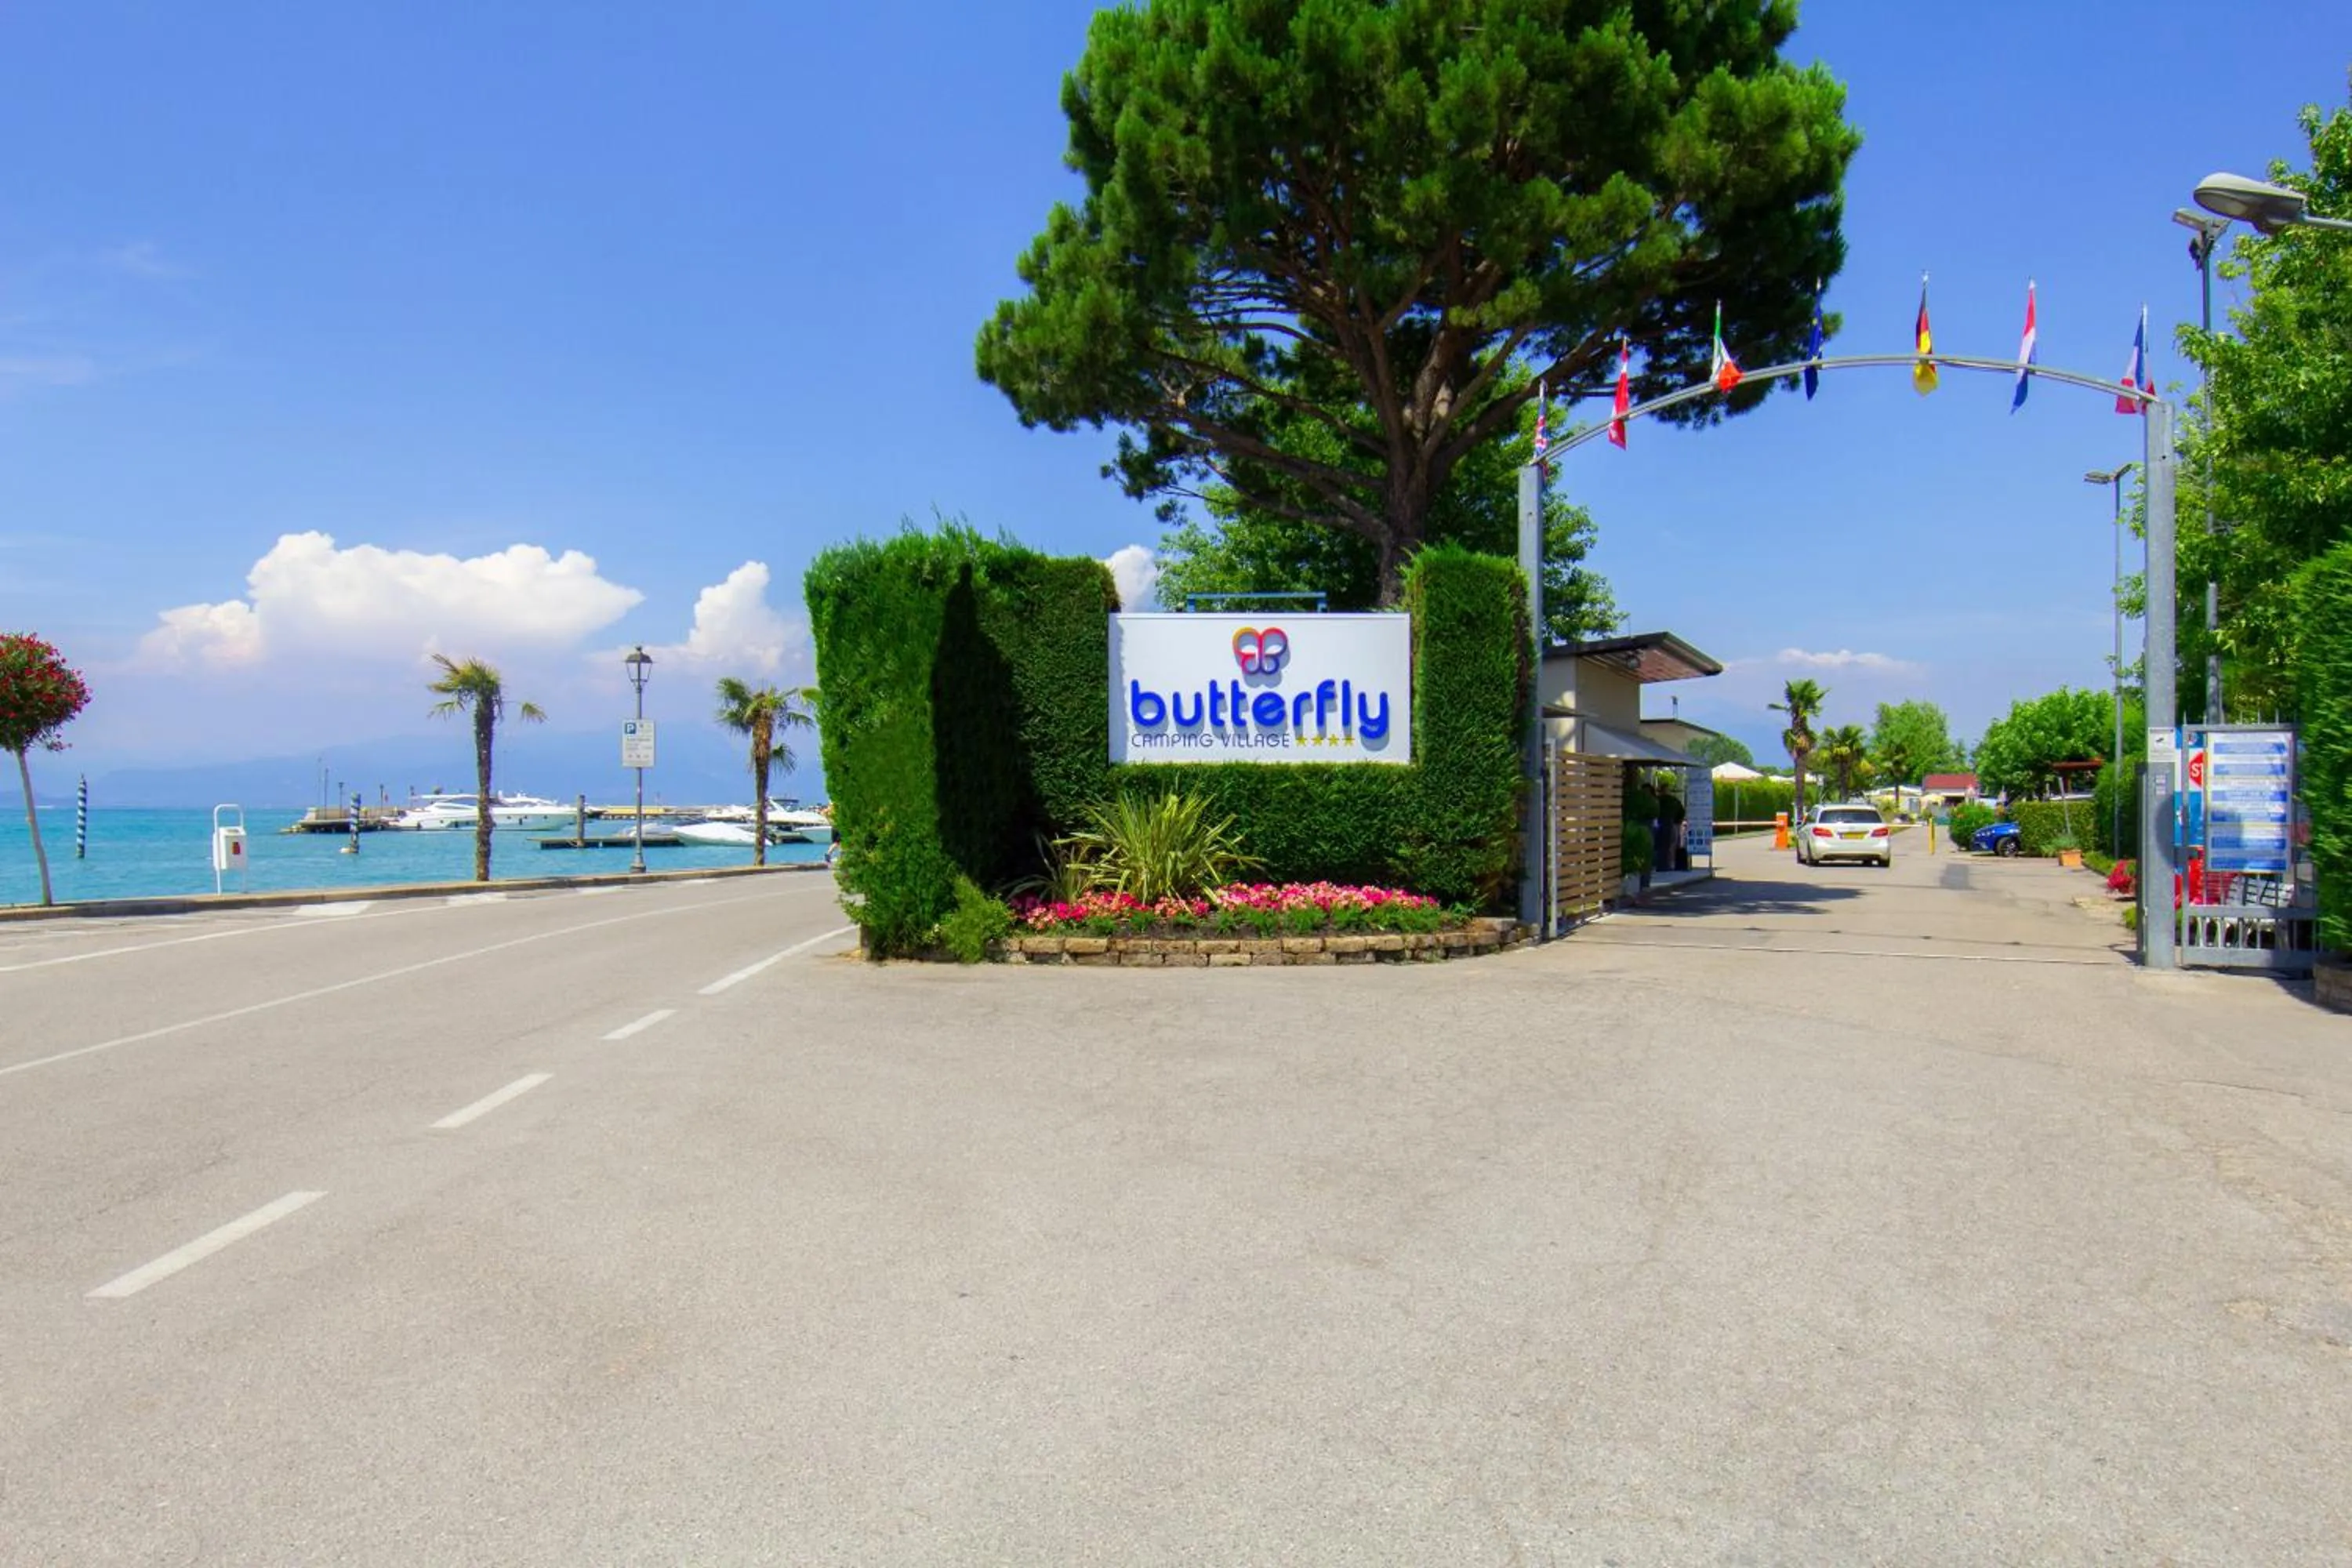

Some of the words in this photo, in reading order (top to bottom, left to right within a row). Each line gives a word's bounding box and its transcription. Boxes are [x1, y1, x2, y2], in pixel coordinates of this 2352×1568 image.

[1131, 679, 1389, 739] butterfly
[1131, 733, 1214, 748] CAMPING
[1221, 733, 1290, 748] VILLAGE
